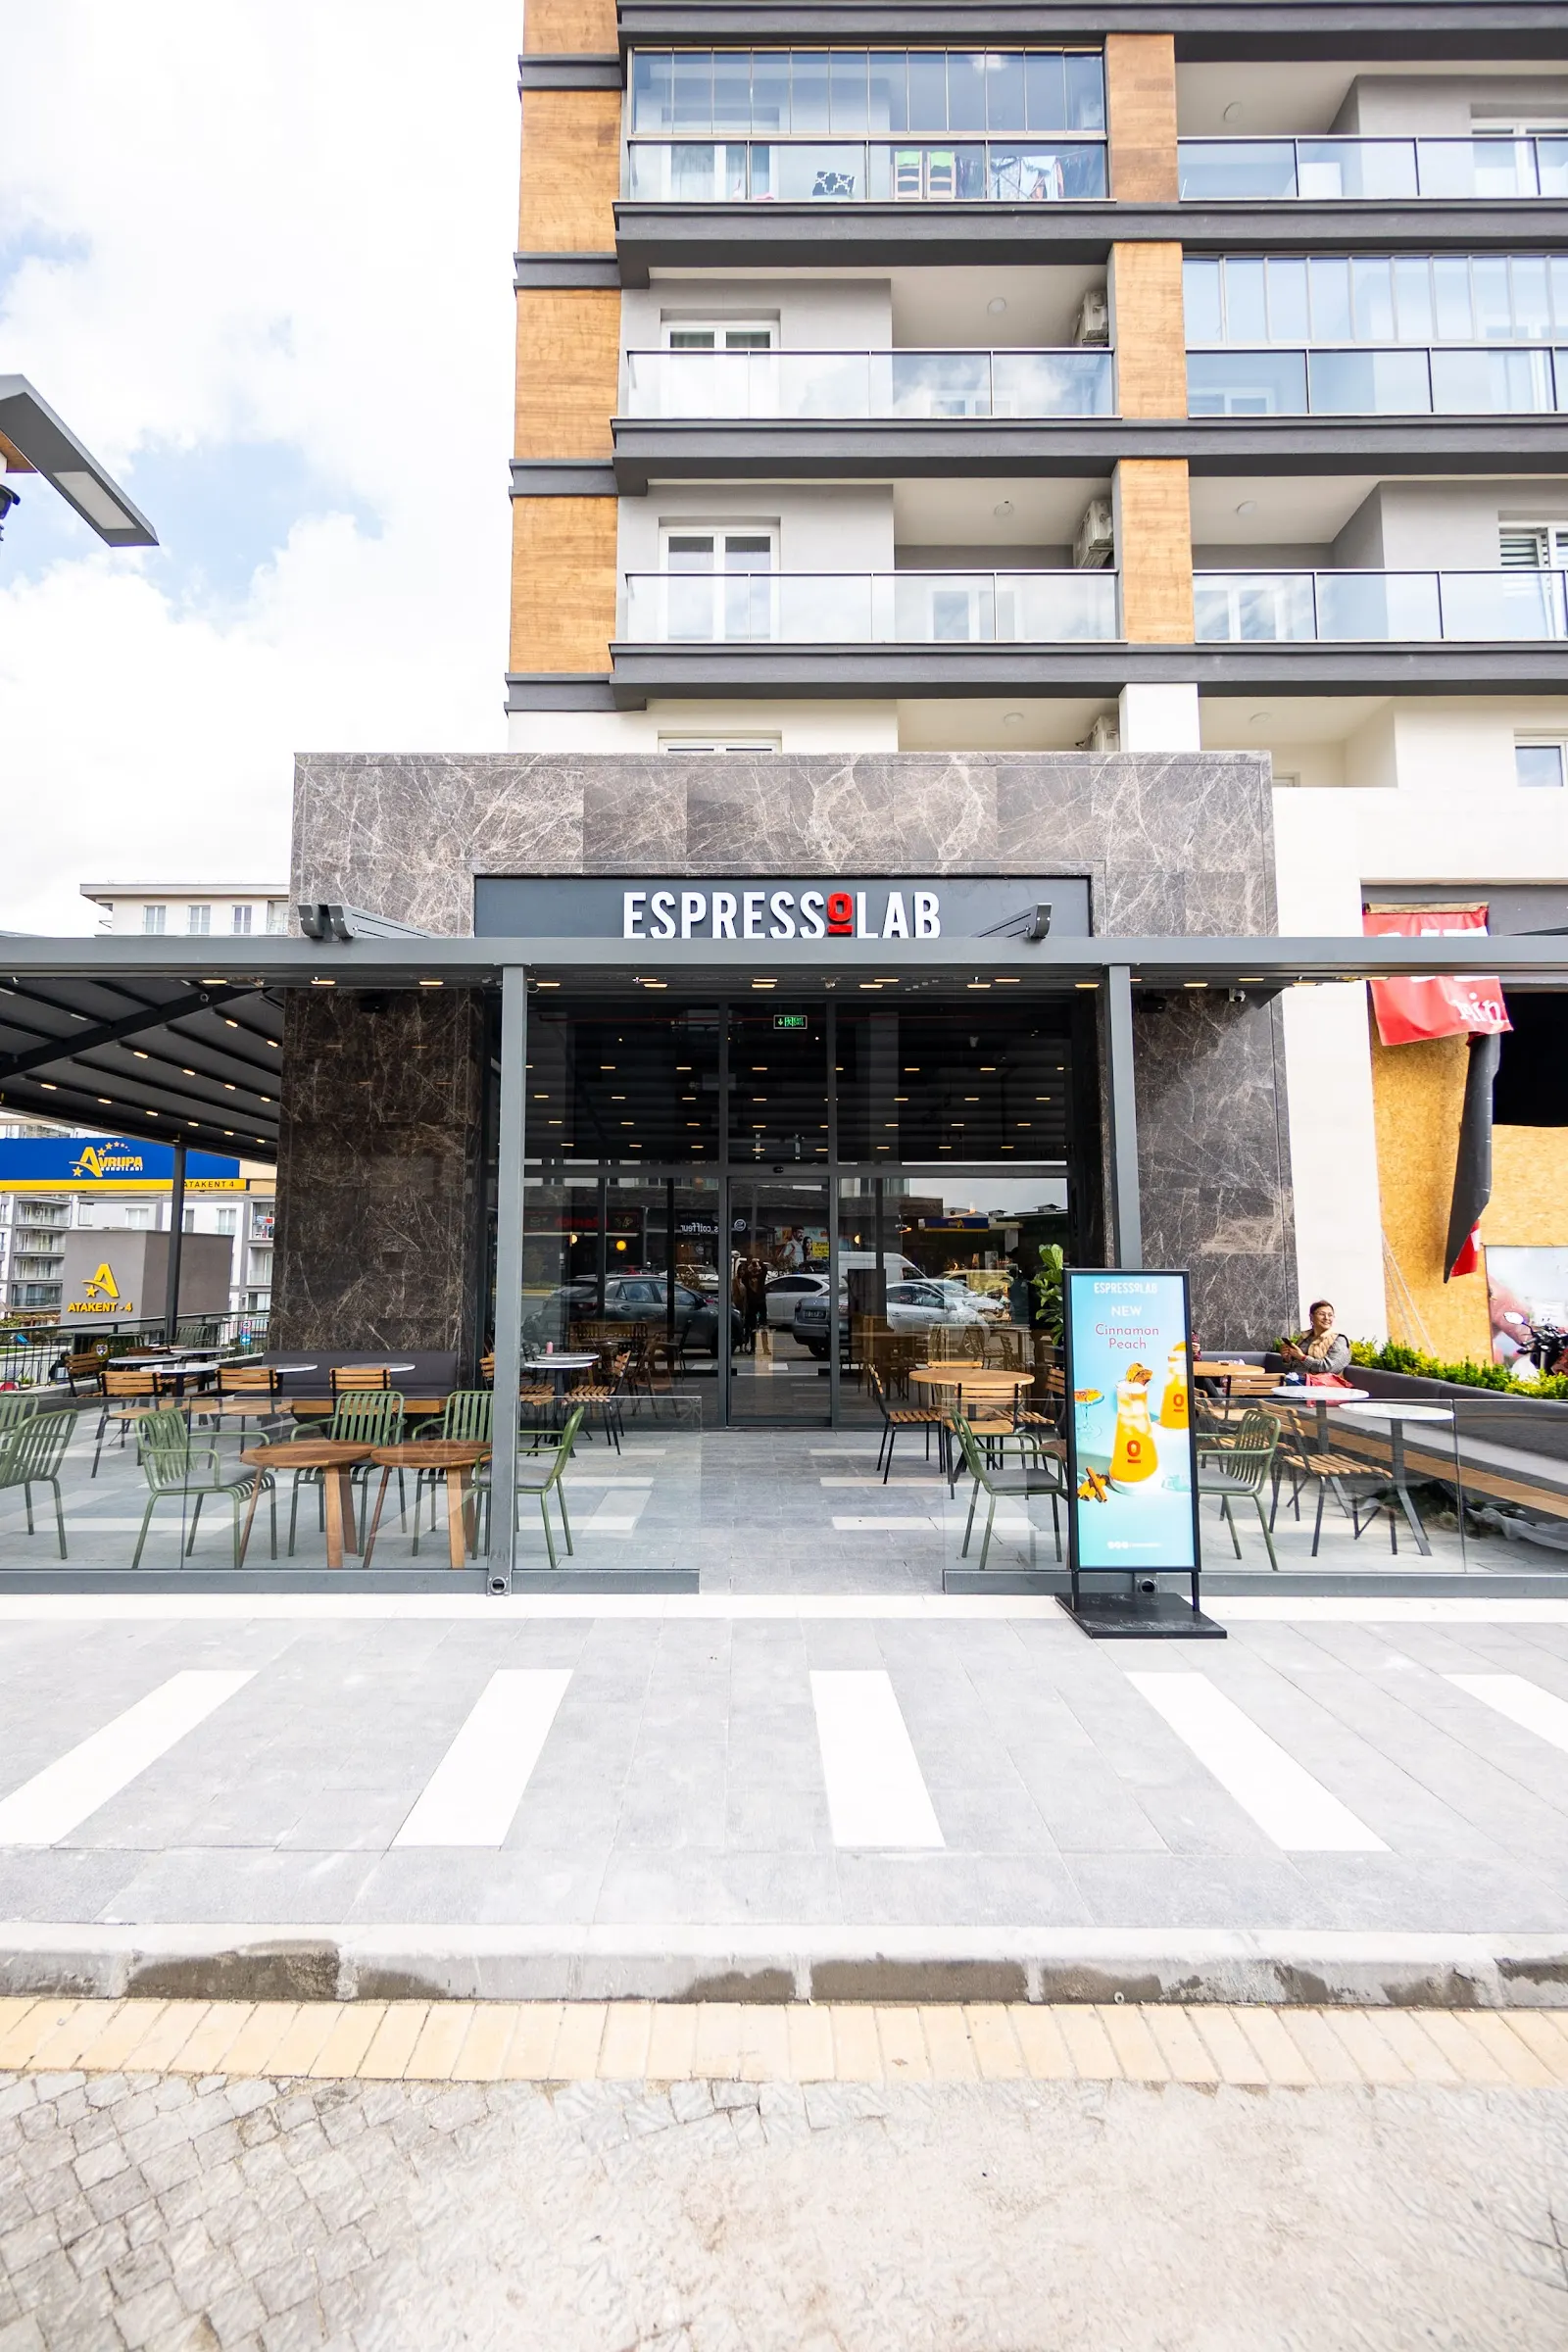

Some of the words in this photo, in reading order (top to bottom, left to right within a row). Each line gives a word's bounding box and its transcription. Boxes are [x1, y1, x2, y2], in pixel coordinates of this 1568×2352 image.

[623, 891, 941, 939] ESPRESSOLAB
[71, 1146, 143, 1177] AVRUPA
[1094, 1282, 1158, 1294] ESPRESSOLAB
[68, 1301, 118, 1312] ATAKENT
[124, 1301, 133, 1312] 4
[1110, 1305, 1143, 1316] NEW
[1095, 1323, 1159, 1336] Cinnamon
[1108, 1337, 1147, 1349] Peach
